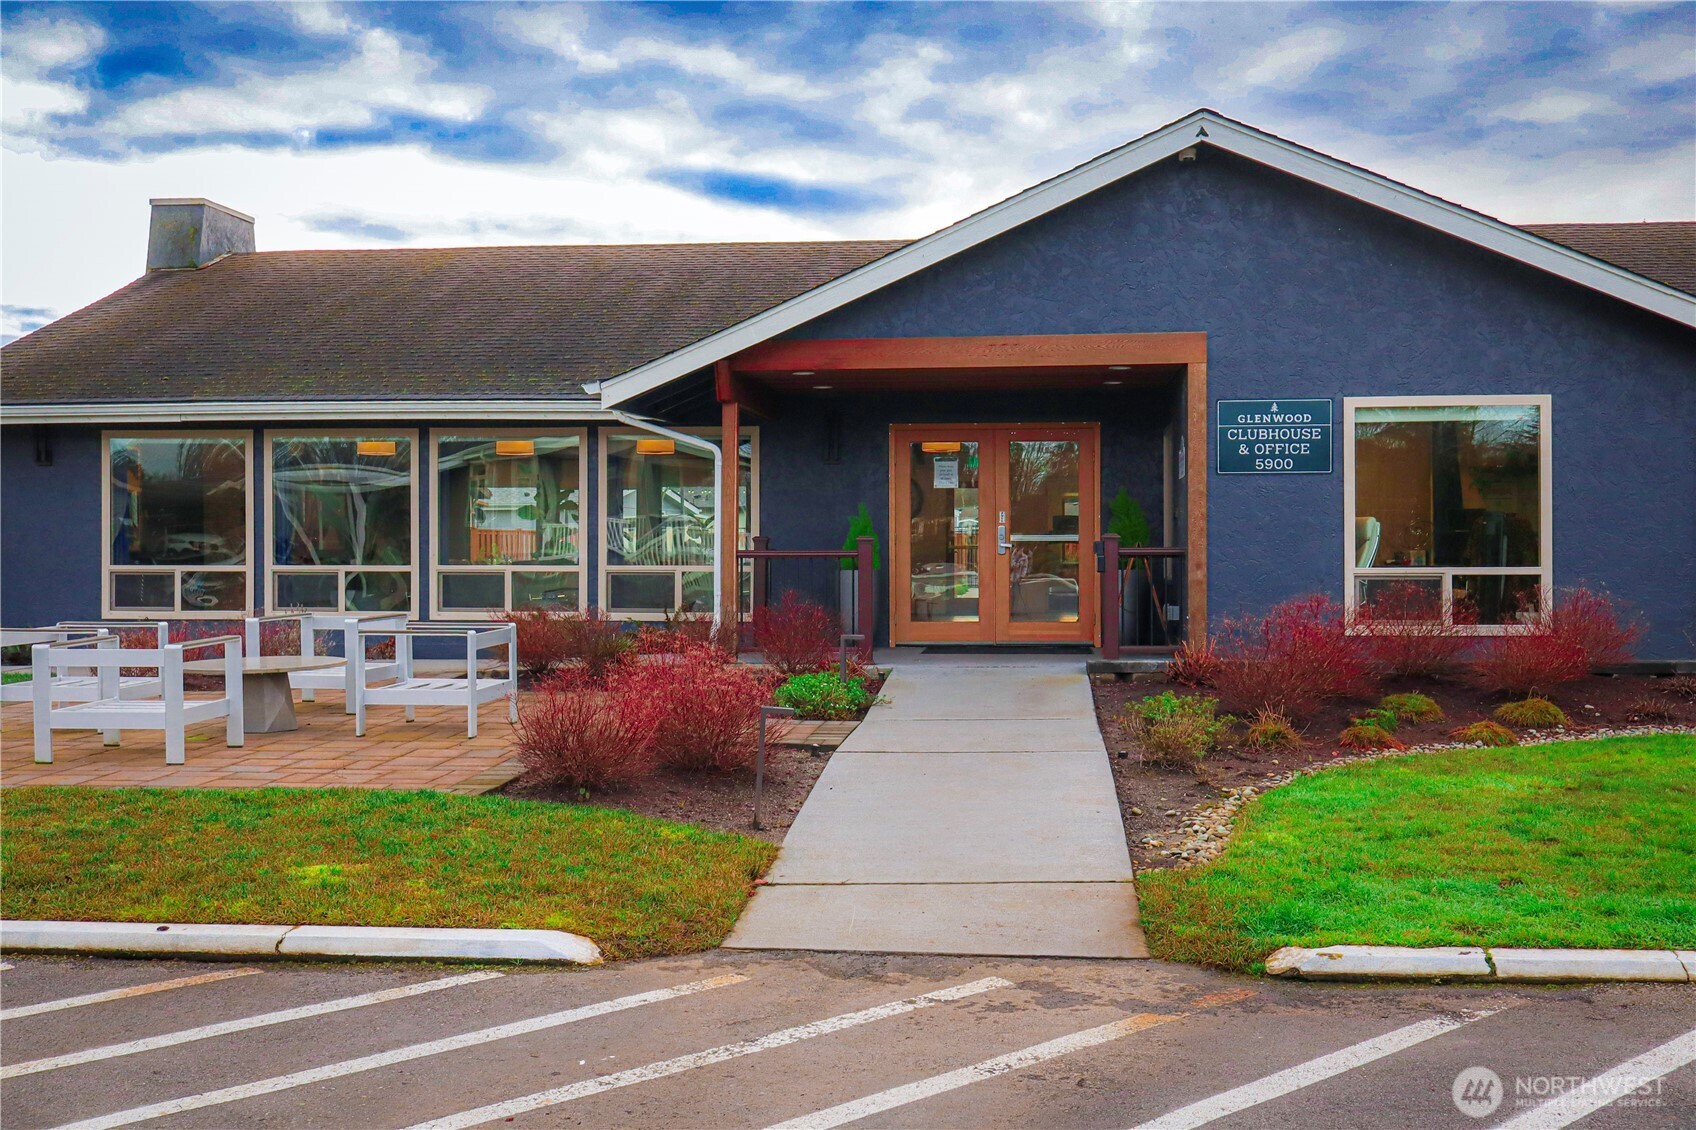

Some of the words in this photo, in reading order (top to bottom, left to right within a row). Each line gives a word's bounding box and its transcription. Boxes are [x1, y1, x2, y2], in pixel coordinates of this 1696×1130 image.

[1237, 413, 1312, 423] GLENWOOD
[1227, 428, 1321, 440] CLUBHOUSE
[1238, 443, 1250, 455] &
[1254, 443, 1310, 455] OFFICE
[1255, 458, 1294, 470] 5900
